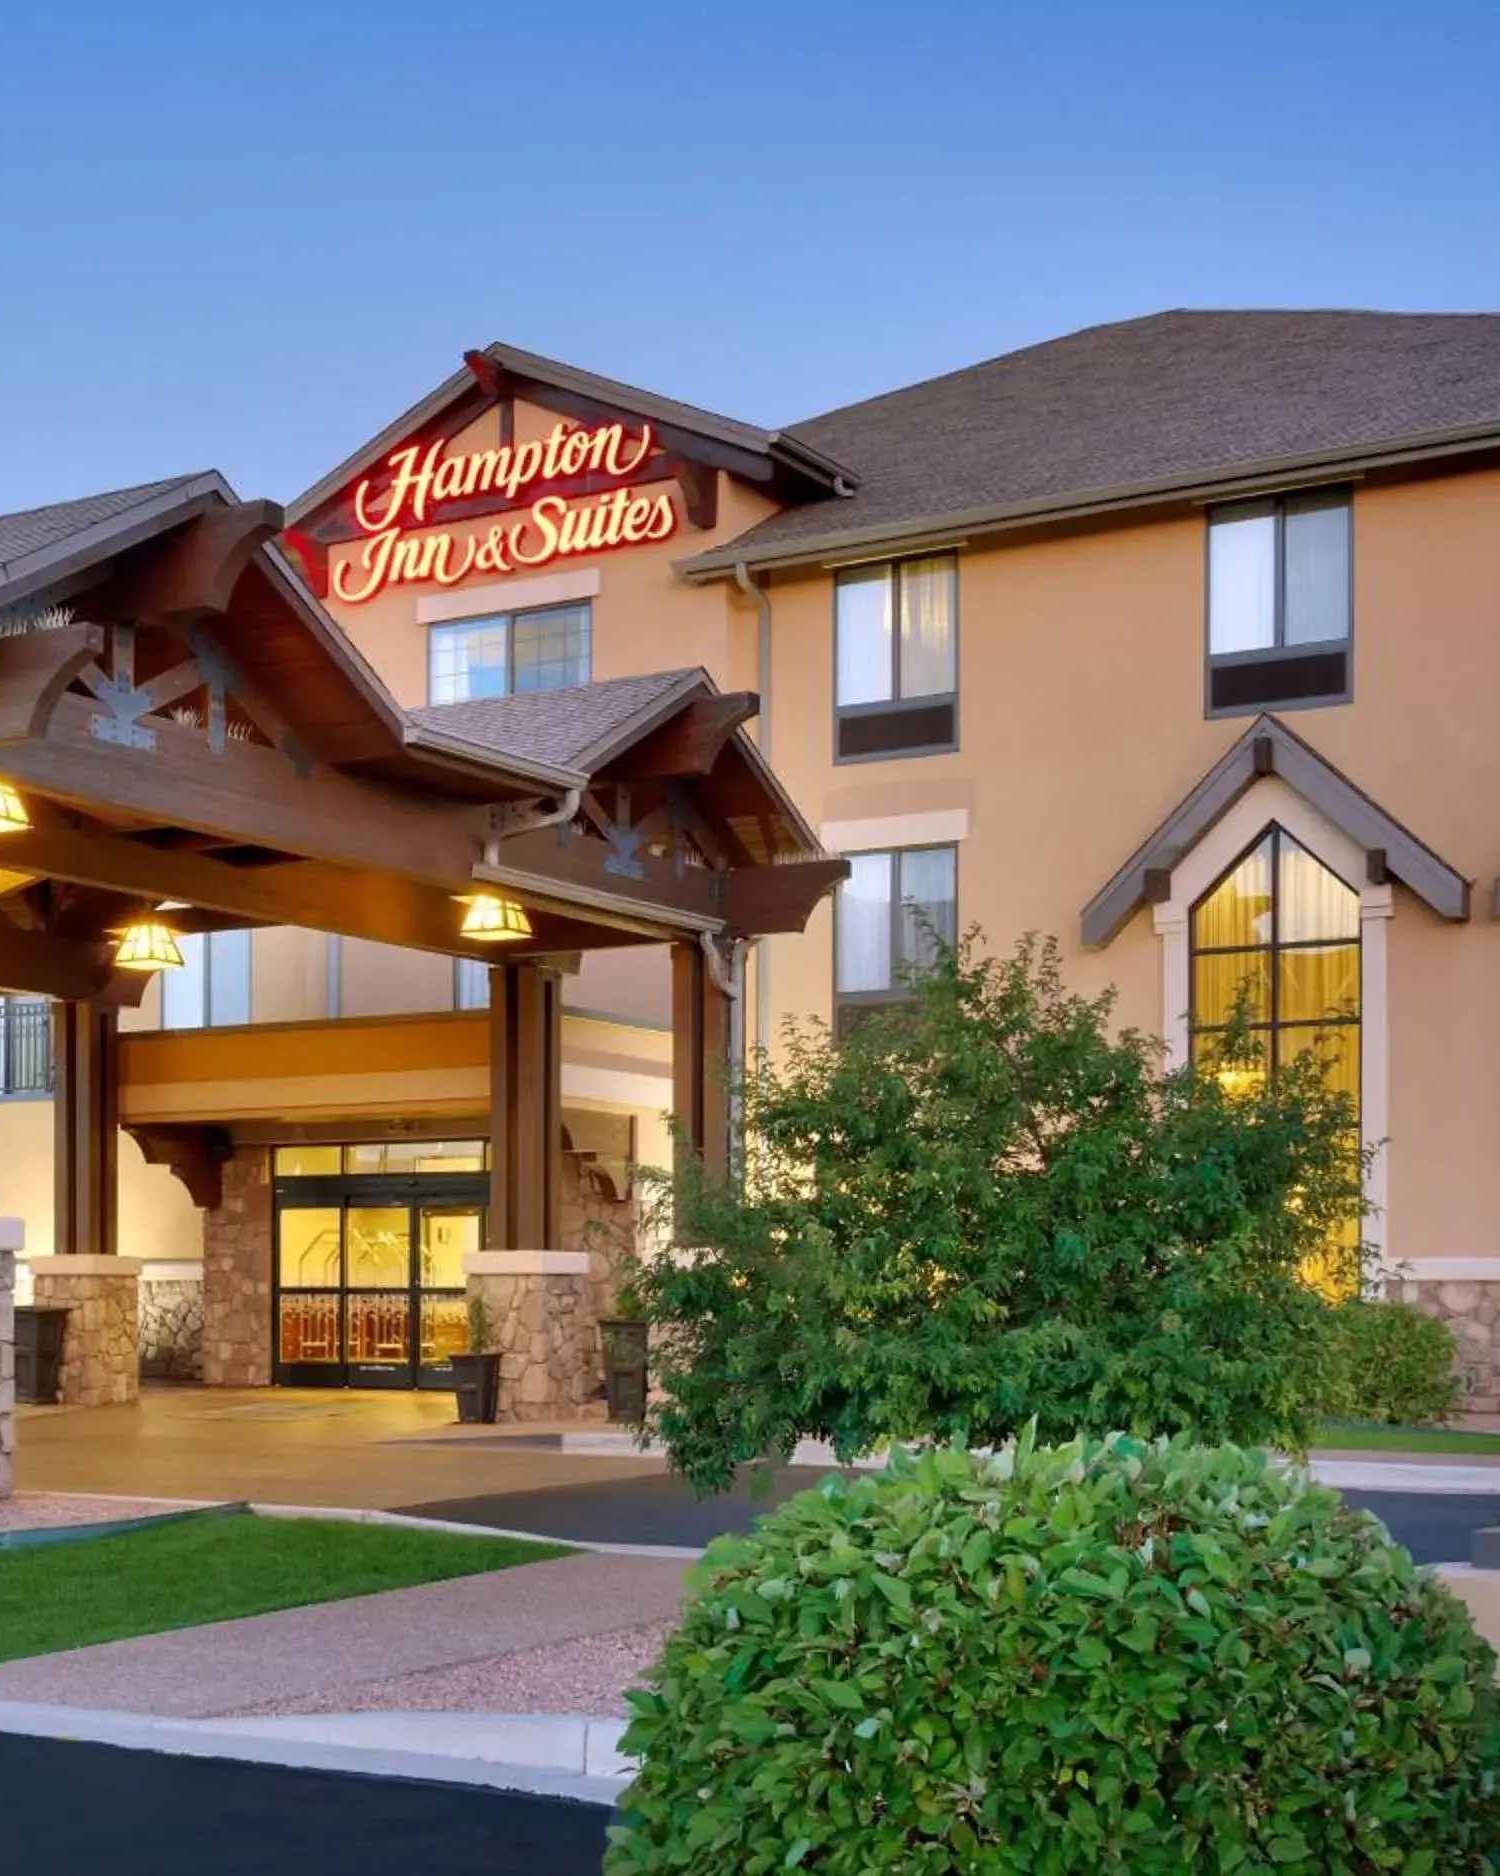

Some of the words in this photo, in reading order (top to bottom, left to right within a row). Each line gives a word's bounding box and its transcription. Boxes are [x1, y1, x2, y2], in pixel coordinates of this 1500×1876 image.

[355, 423, 651, 531] Hampton
[333, 527, 476, 603] Inn
[475, 526, 512, 571] &
[509, 488, 674, 564] Suites
